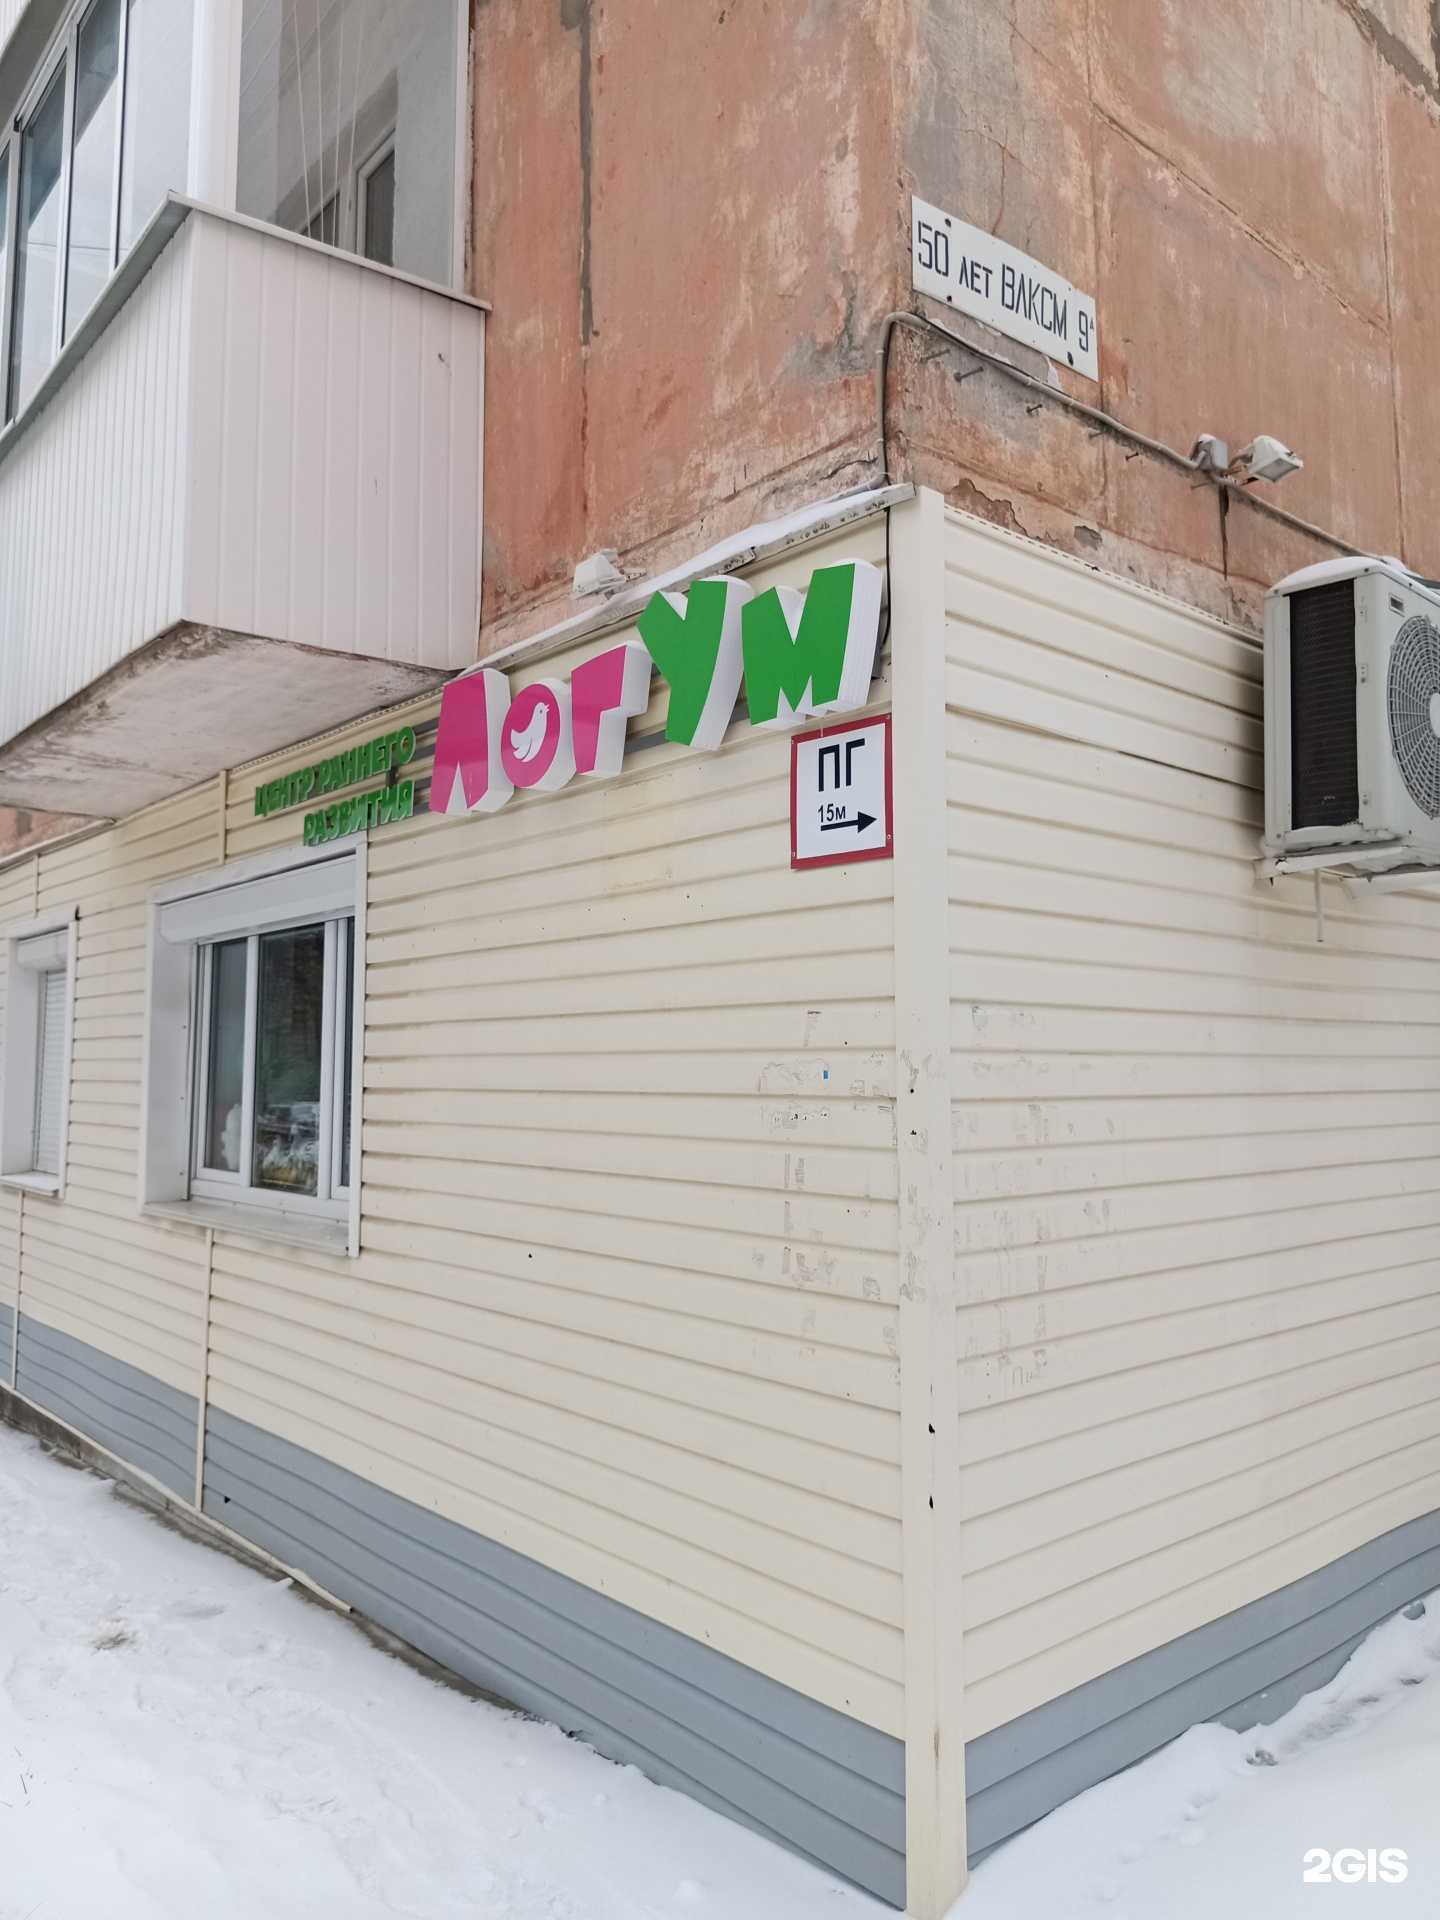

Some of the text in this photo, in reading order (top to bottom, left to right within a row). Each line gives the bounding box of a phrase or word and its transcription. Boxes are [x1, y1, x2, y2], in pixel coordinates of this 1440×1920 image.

[917, 220, 950, 278] 50
[1001, 263, 1068, 341] ВЛКСМ
[254, 726, 417, 818] ЦЕНТР РАННЕГО
[818, 737, 866, 793] ПГ
[303, 779, 416, 847] РАЗВИТИЯ
